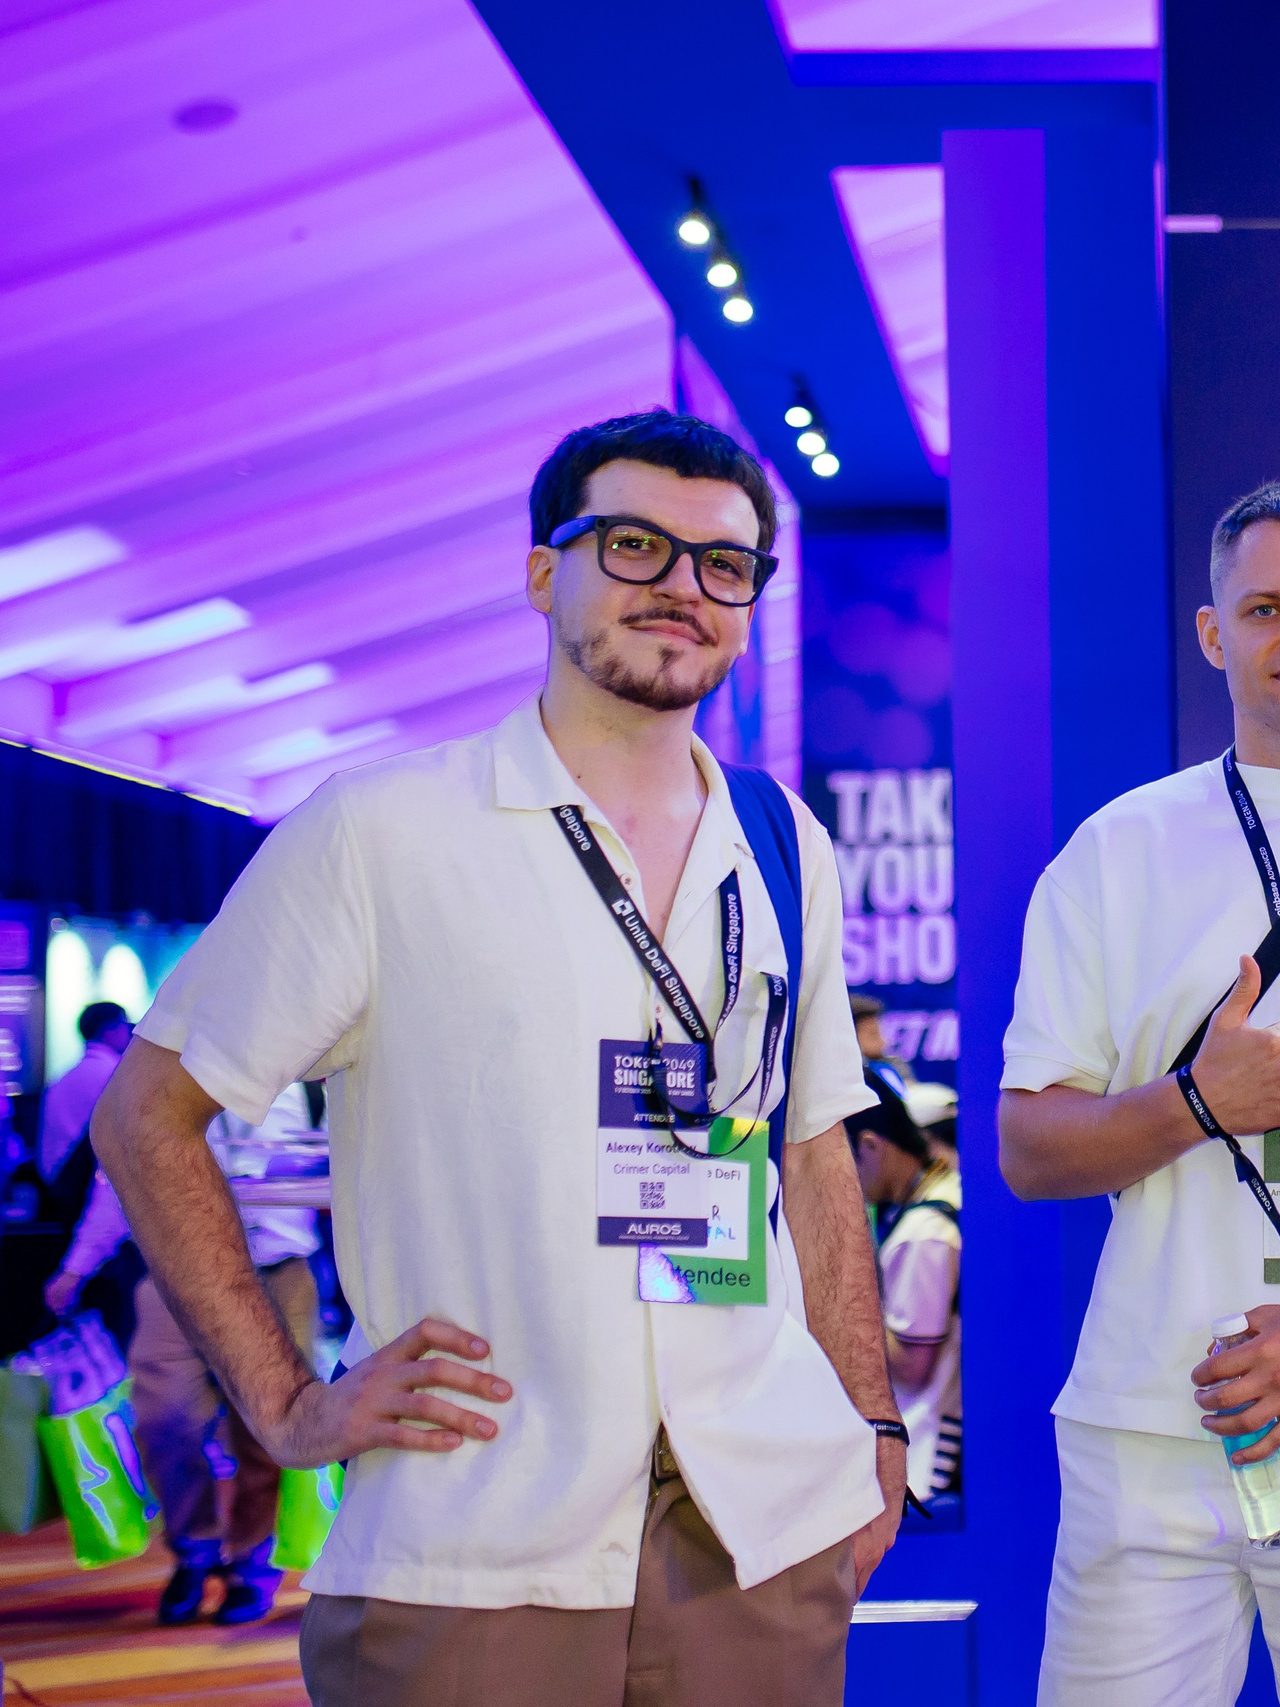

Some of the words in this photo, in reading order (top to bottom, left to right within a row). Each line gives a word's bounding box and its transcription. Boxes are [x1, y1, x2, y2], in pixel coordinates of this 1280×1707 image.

[560, 805, 592, 851] gapore
[726, 893, 742, 954] Singapore
[624, 912, 650, 950] Unite
[644, 948, 673, 981] DeFi
[664, 974, 704, 1040] Singapore
[727, 954, 739, 984] DeFi
[614, 1069, 695, 1089] SINGORE
[633, 1113, 676, 1124] ATTENDE
[1188, 1088, 1215, 1131] TOKEN2049
[606, 1142, 644, 1156] Alexey
[613, 1163, 650, 1175] Crimer
[652, 1162, 691, 1177] Capital
[715, 1168, 741, 1181] DeFi
[626, 1223, 683, 1235] AUROS
